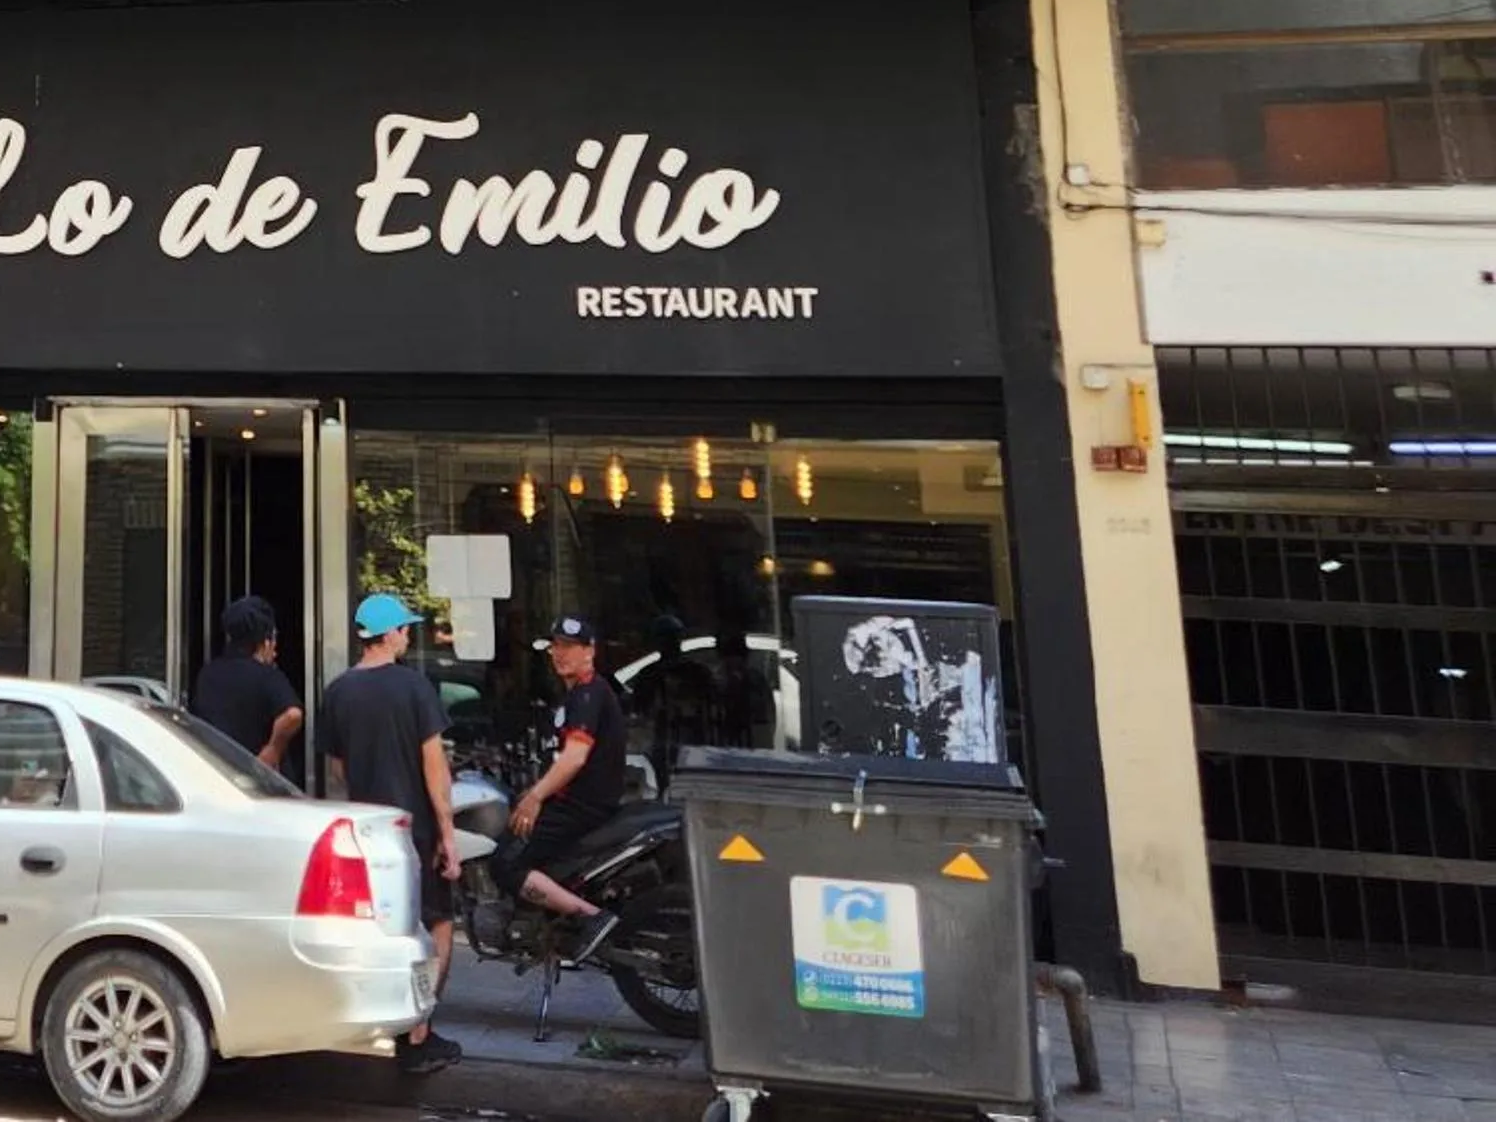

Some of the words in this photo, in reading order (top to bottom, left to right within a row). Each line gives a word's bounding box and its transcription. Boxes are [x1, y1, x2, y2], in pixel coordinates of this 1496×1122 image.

[160, 147, 317, 258] de
[356, 113, 779, 254] Emilio
[578, 287, 817, 318] RESTAURANT
